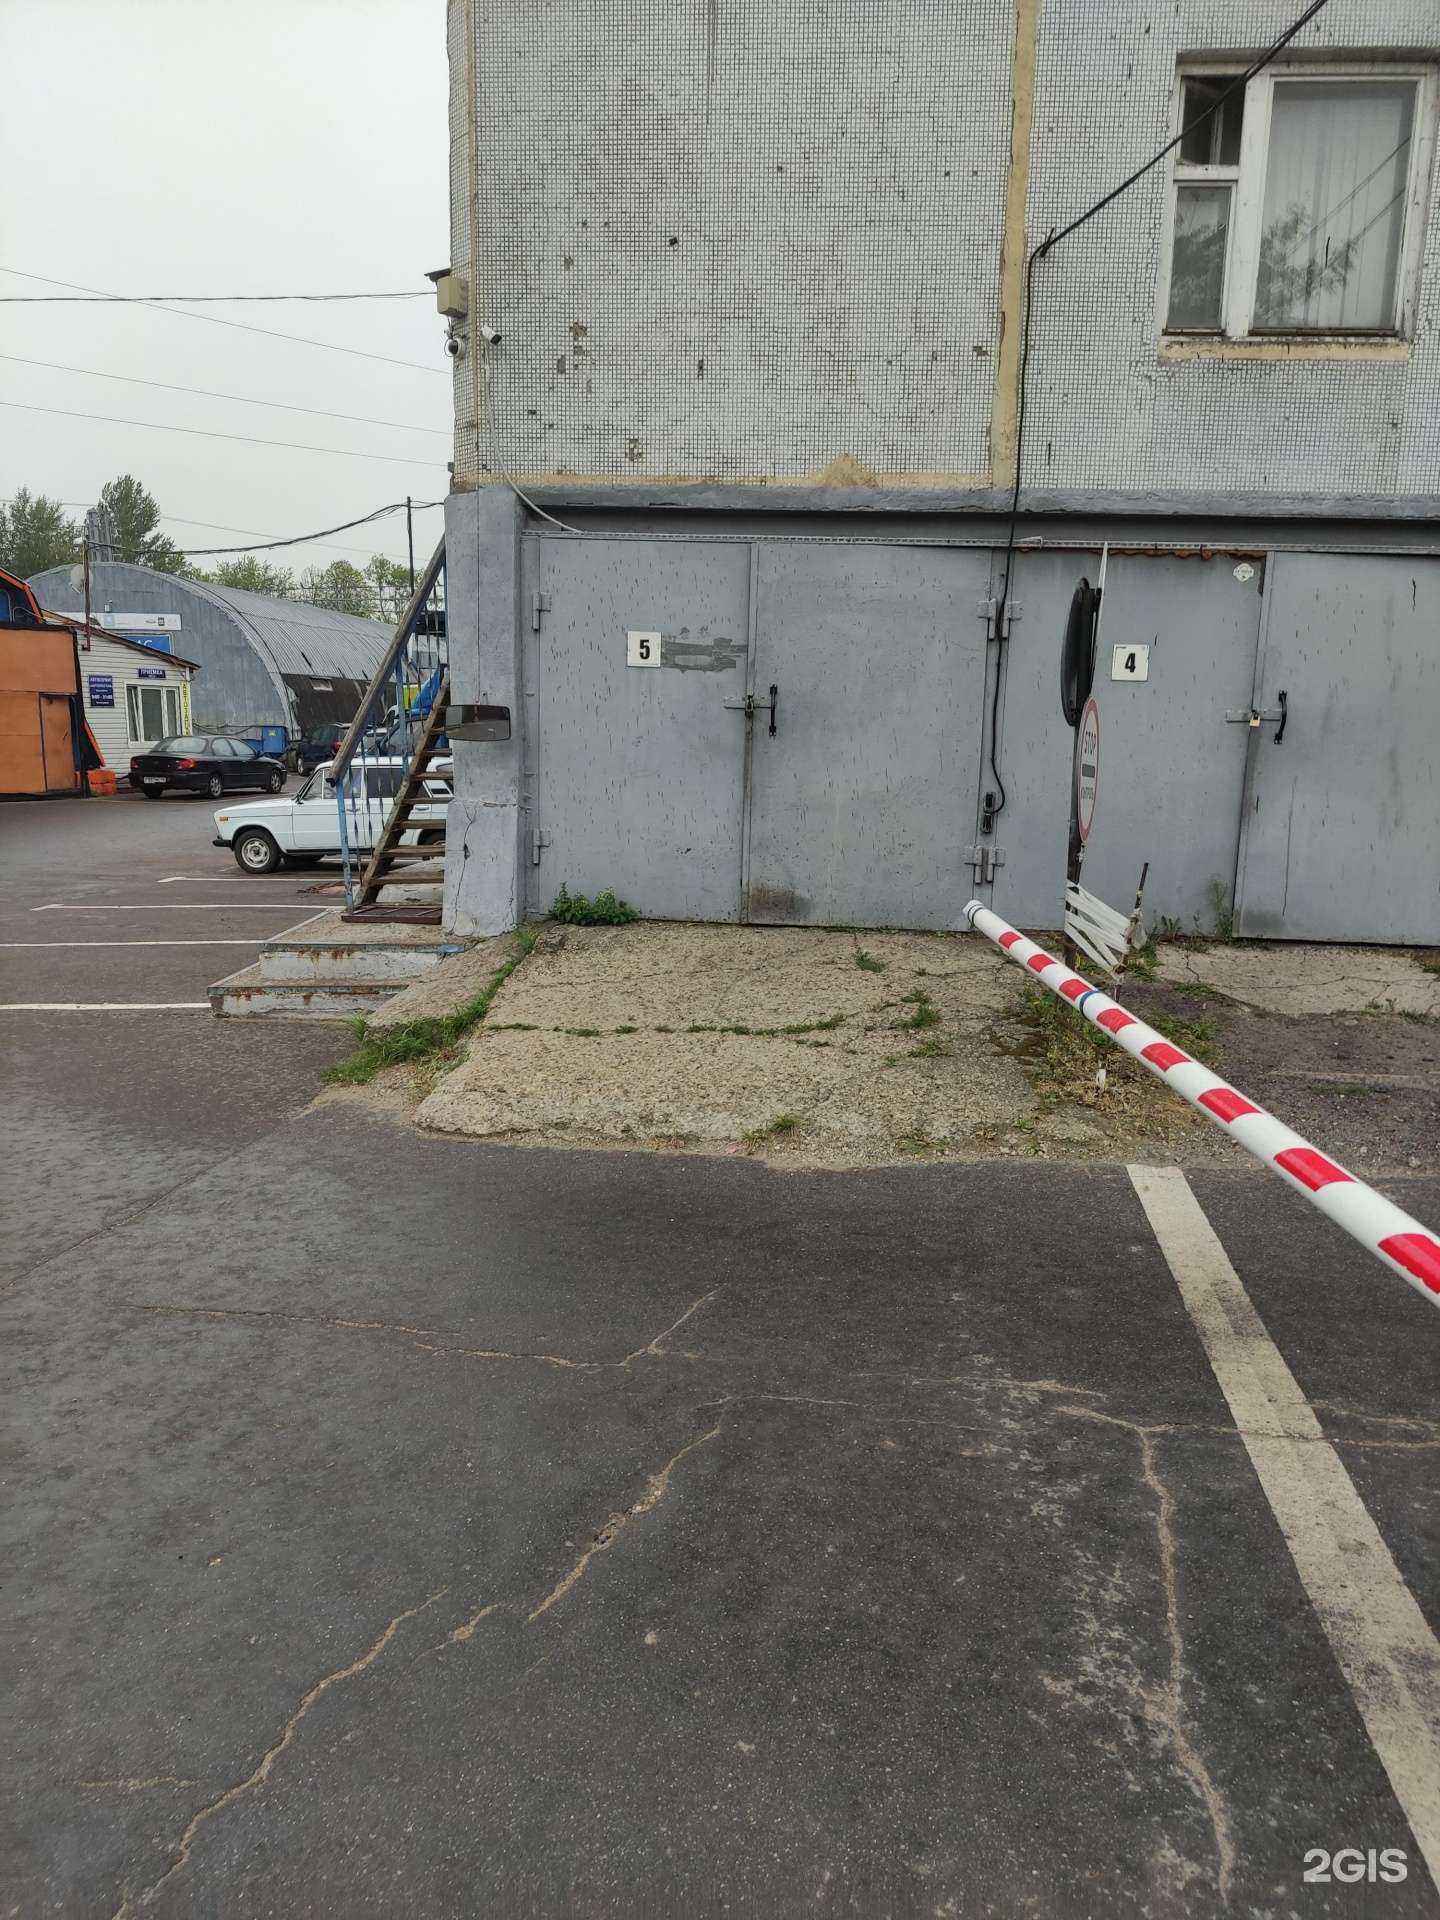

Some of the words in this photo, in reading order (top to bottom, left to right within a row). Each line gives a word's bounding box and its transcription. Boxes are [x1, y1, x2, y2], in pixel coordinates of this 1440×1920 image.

[640, 639, 650, 660] 5
[1125, 652, 1136, 673] 4
[1084, 730, 1097, 757] STOP
